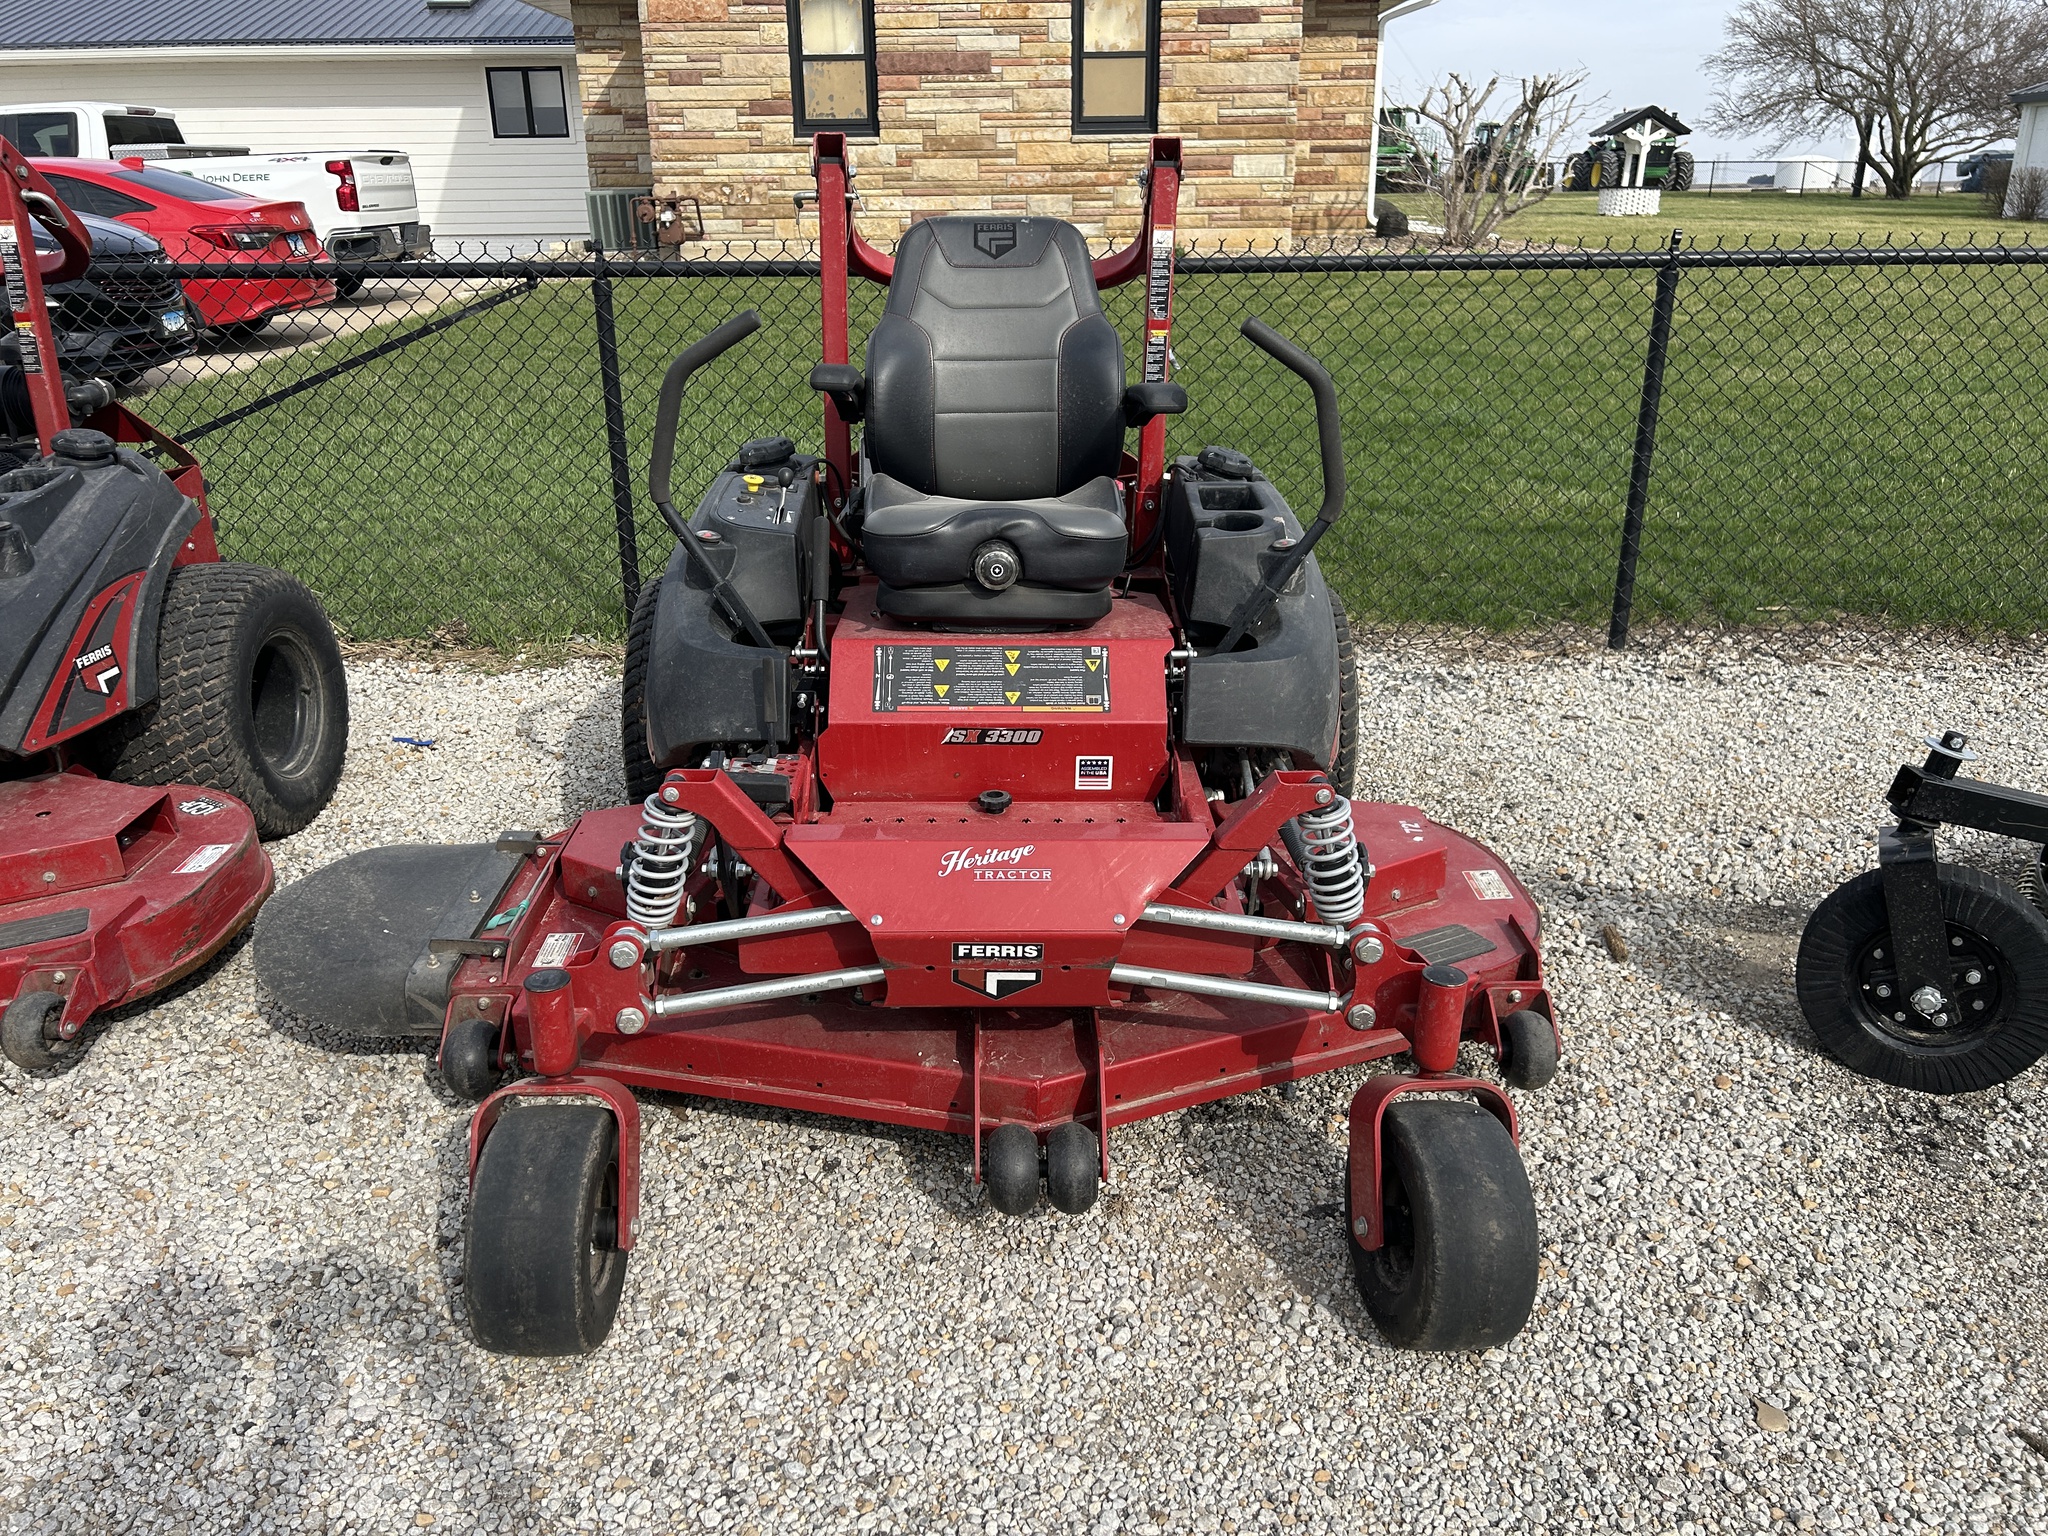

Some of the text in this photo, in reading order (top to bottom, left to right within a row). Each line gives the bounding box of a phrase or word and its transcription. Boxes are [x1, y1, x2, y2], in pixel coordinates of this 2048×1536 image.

[233, 173, 271, 182] DEERE
[977, 223, 1014, 231] FERRIS
[75, 645, 112, 669] FERRIS
[985, 730, 1041, 743] 3300
[938, 844, 1036, 877] Heritage
[974, 870, 1052, 880] TRACTOR
[958, 945, 1039, 957] FERRIS
